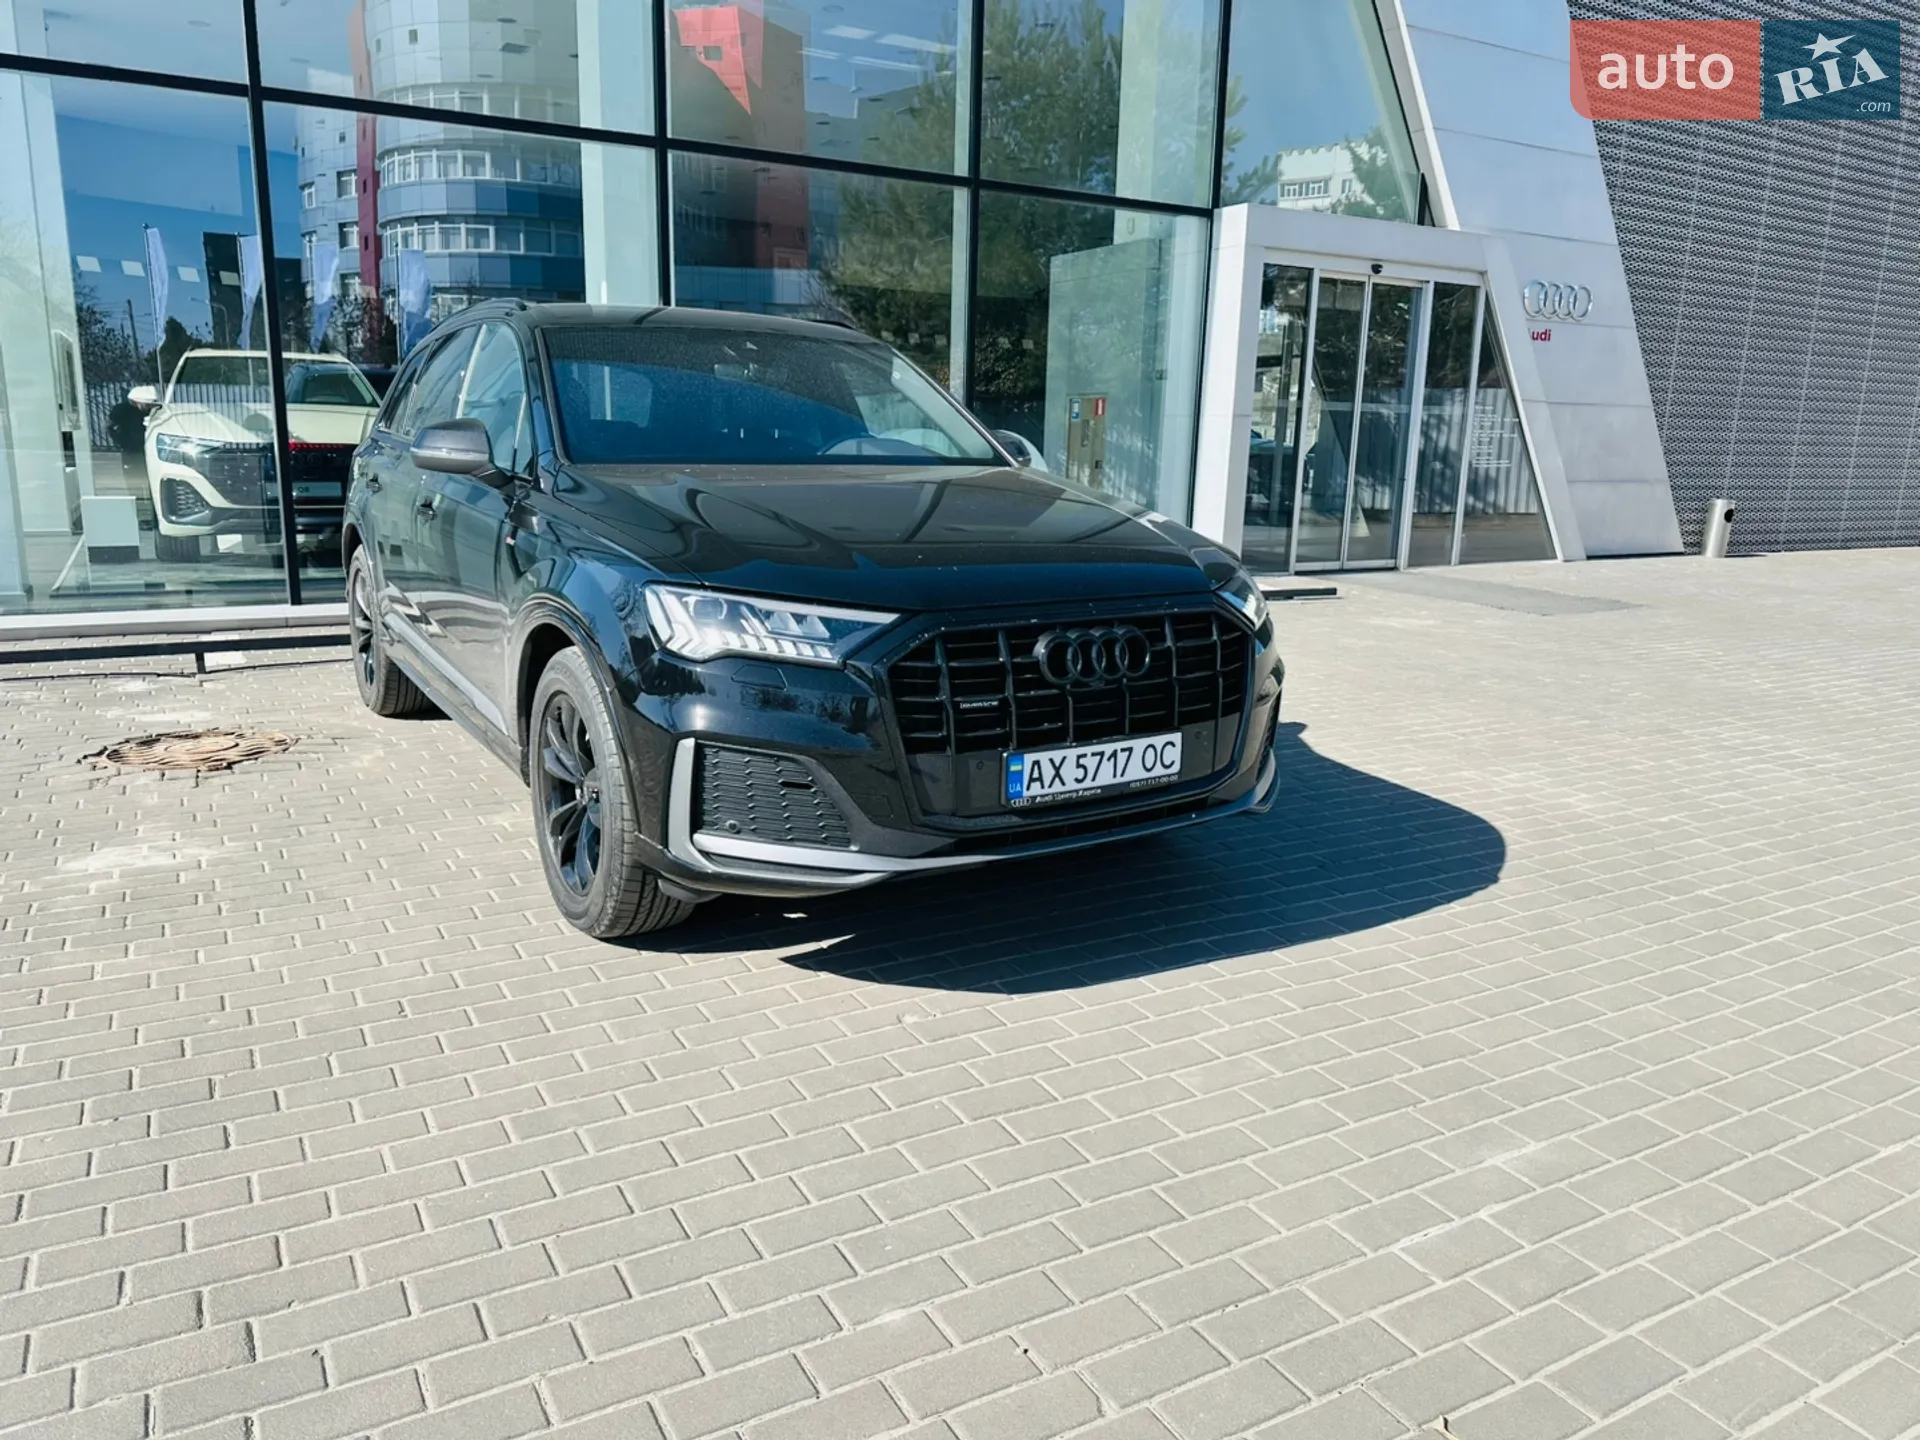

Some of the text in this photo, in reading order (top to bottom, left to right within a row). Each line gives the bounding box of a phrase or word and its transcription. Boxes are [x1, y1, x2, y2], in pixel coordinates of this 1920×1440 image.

[1026, 741, 1177, 792] AX 5717 OC
[1009, 783, 1022, 793] UA
